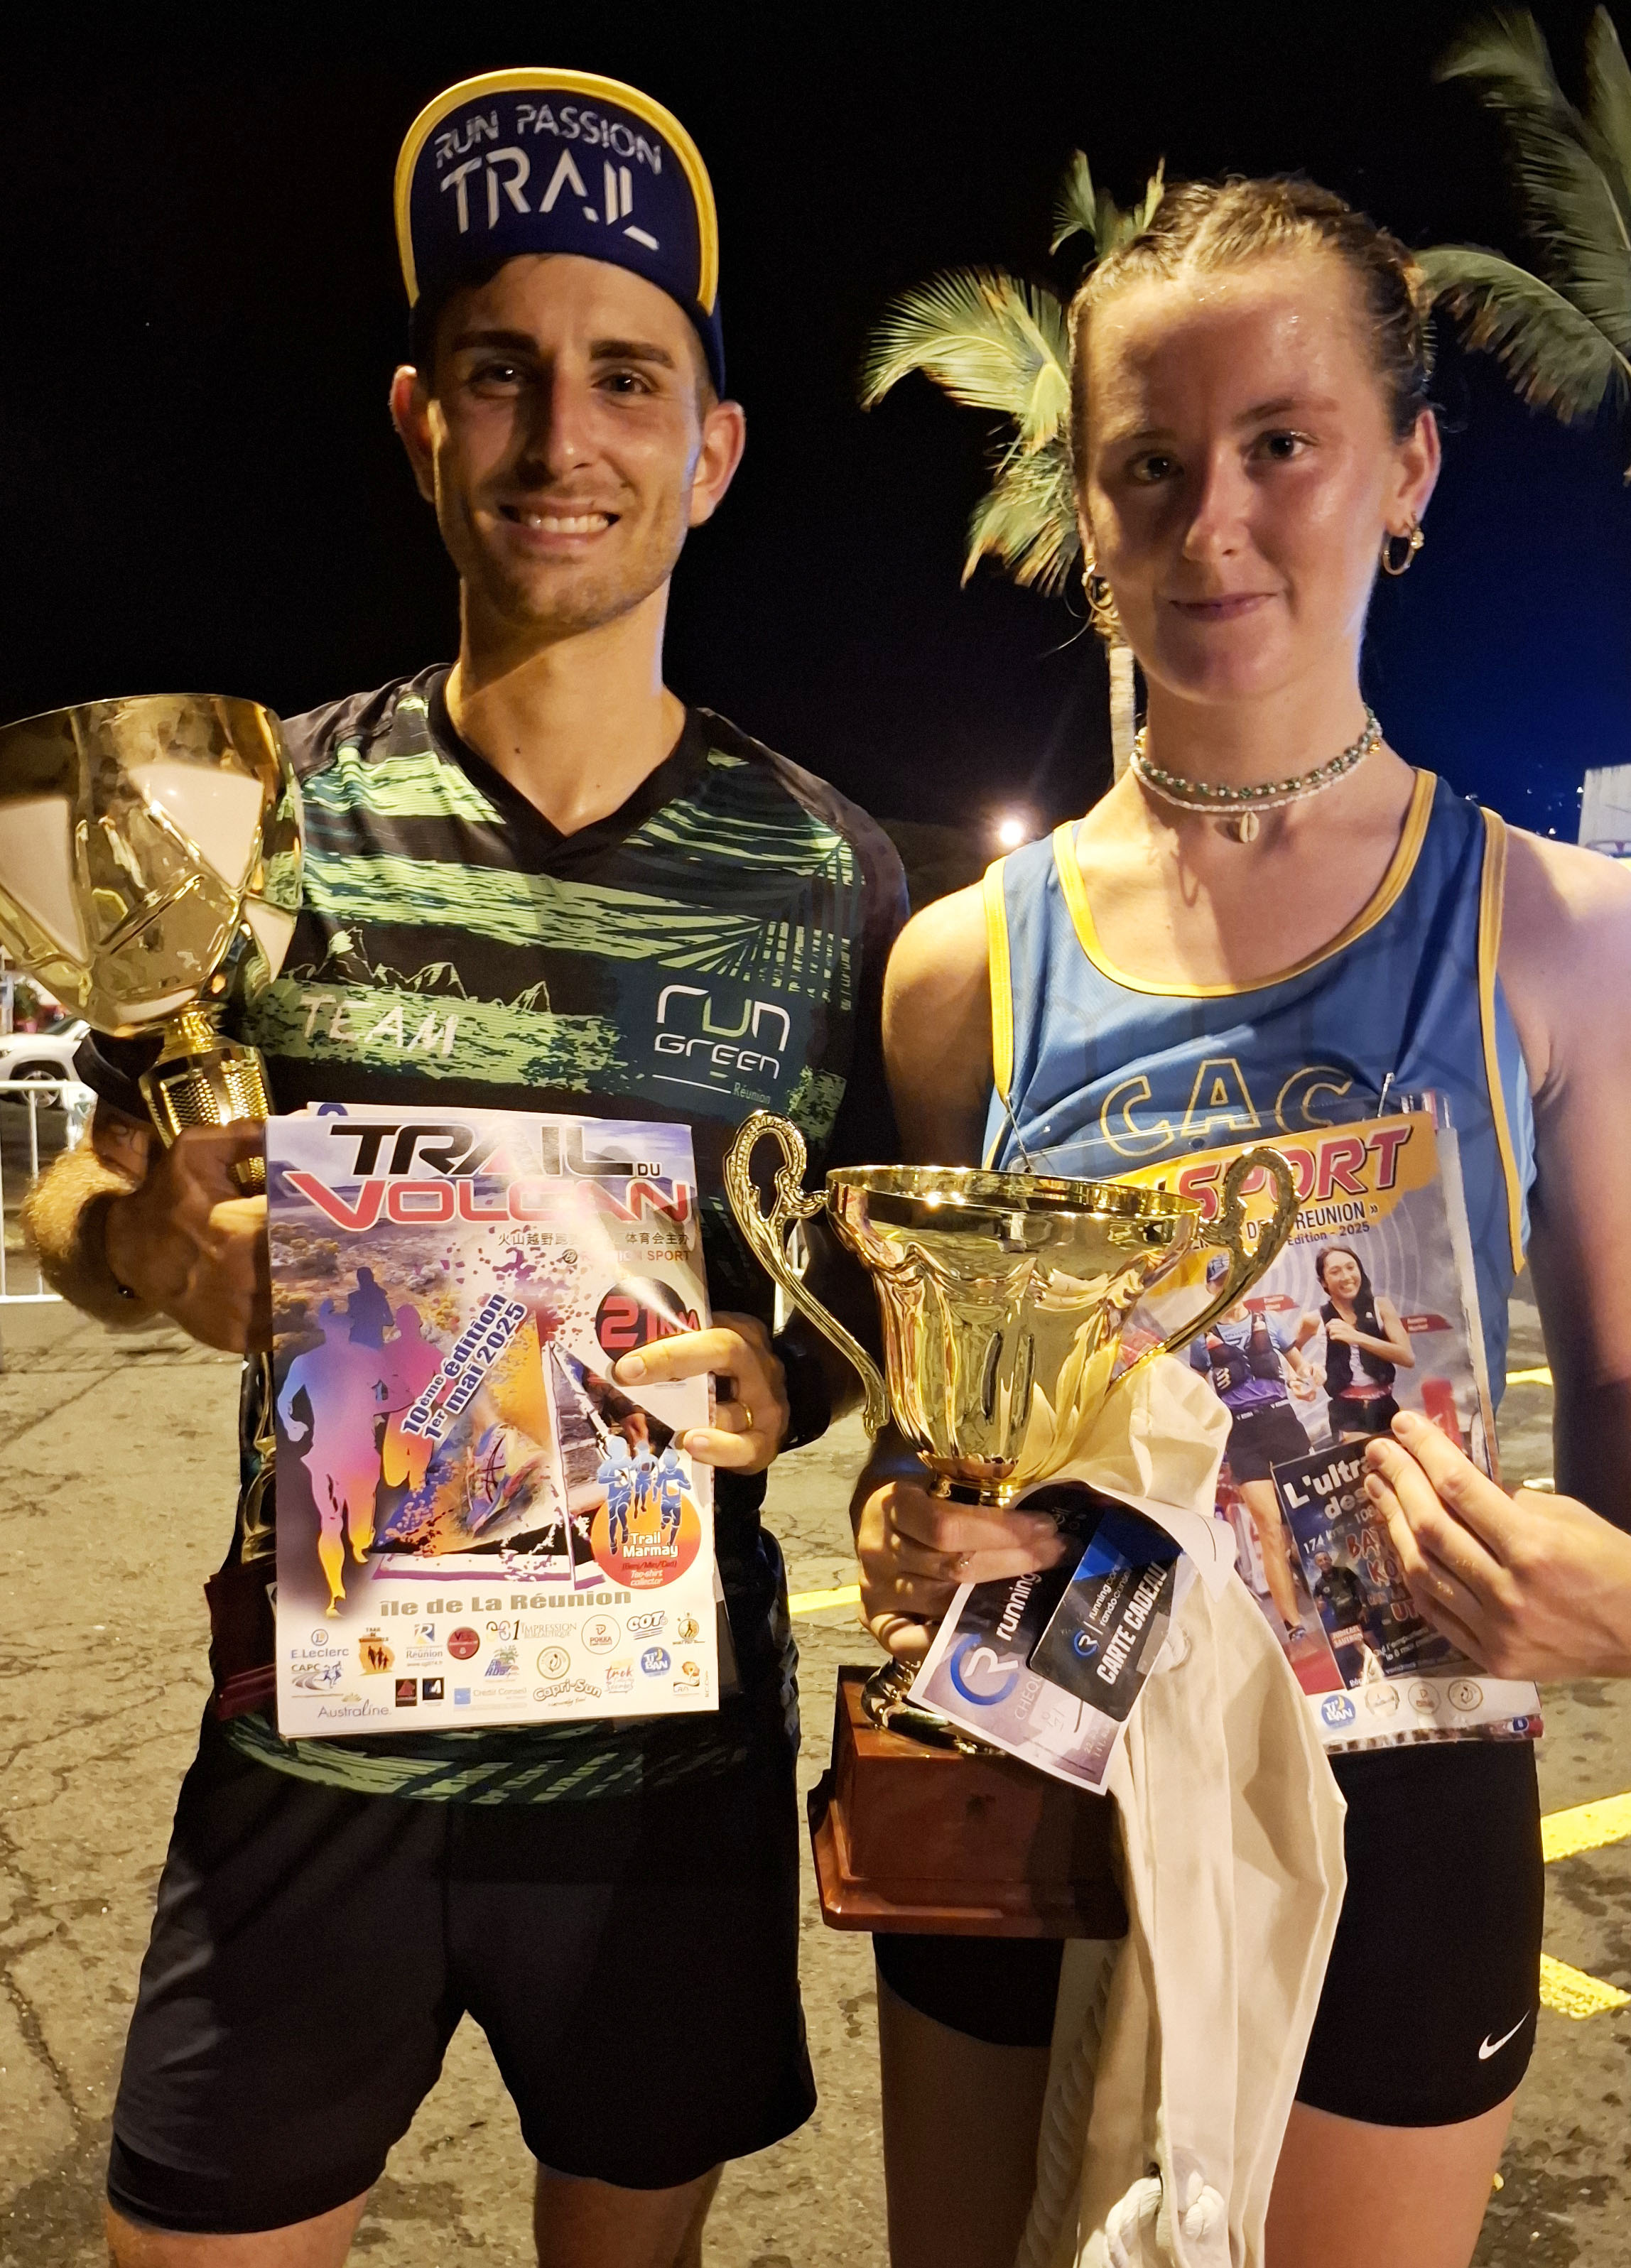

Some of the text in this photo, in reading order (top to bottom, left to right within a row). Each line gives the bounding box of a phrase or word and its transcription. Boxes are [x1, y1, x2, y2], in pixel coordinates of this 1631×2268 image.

[434, 103, 662, 175] RUN PASSION
[440, 146, 660, 251] TRAIL
[300, 994, 459, 1056] TEAM
[1100, 1058, 1355, 1157] CAC
[330, 1124, 661, 1176] TRAIL DU
[283, 1171, 690, 1232] VOLCAN
[1295, 1202, 1366, 1231] REUNION
[1338, 1222, 1370, 1237] 2025
[646, 1249, 690, 1261] SPORT
[443, 1293, 507, 1377] édition
[445, 1363, 485, 1413] mai
[475, 1301, 526, 1365] 2025
[622, 1544, 680, 1558] Marmay
[629, 1531, 661, 1546] Trail
[426, 1597, 463, 1615] de
[472, 1595, 502, 1612] La
[509, 1590, 632, 1611] Réunion
[996, 1572, 1043, 1642] running
[627, 1611, 665, 1631] COT
[1096, 1624, 1137, 1686] CARTE
[1123, 1561, 1168, 1632] CADEAU
[291, 1663, 320, 1672] CAPC
[605, 1665, 634, 1681] trek
[644, 1660, 668, 1671] BAN
[533, 1678, 602, 1703] Capri-Sun
[318, 1698, 389, 1718] Australine
